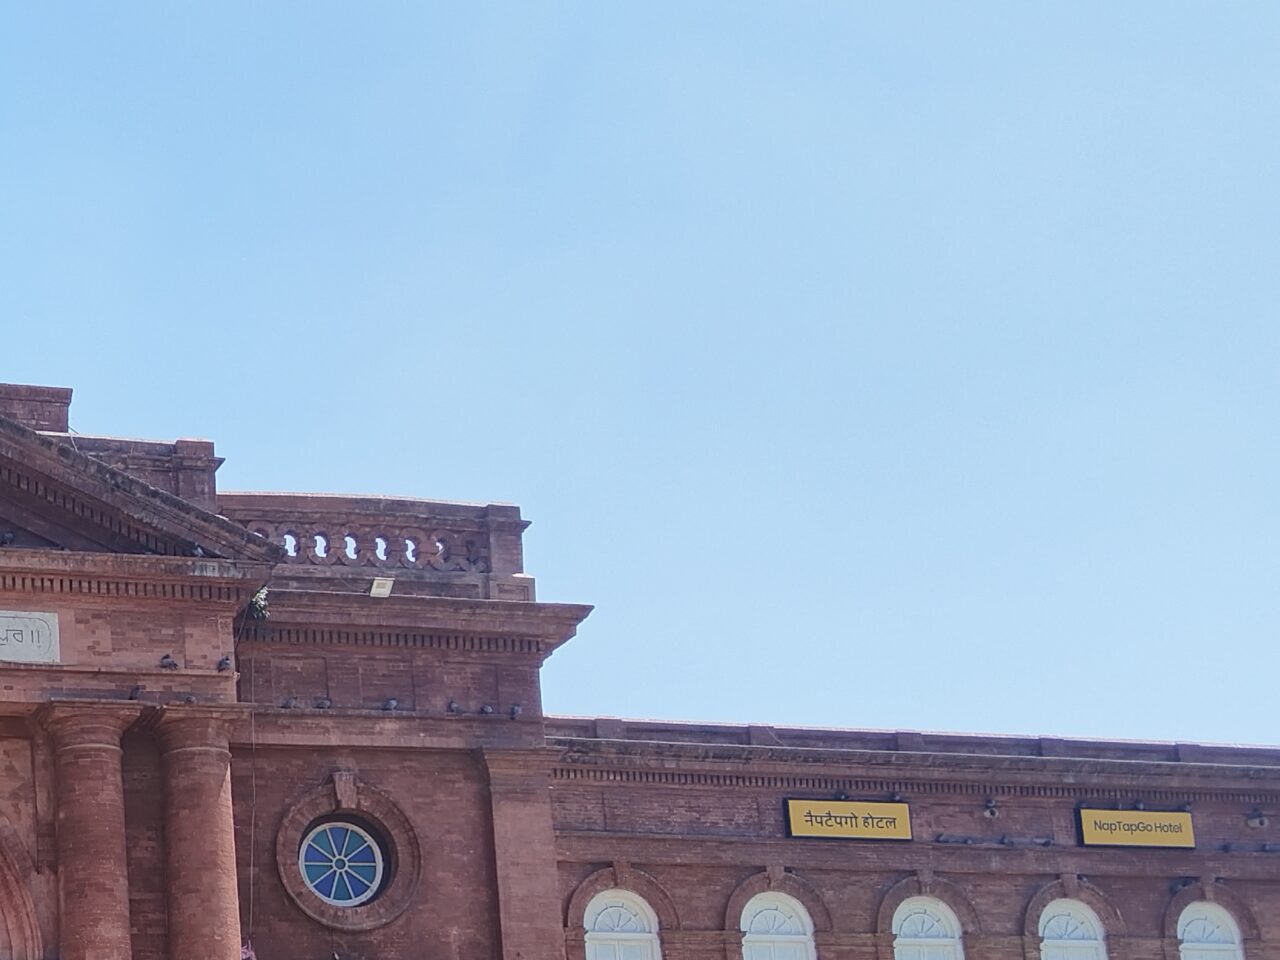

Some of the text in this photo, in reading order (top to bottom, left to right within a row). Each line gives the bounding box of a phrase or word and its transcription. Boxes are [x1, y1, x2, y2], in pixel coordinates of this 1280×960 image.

[803, 809, 897, 829] नैपटैपगो होटल
[1093, 819, 1183, 835] NapTapGo Hotel
